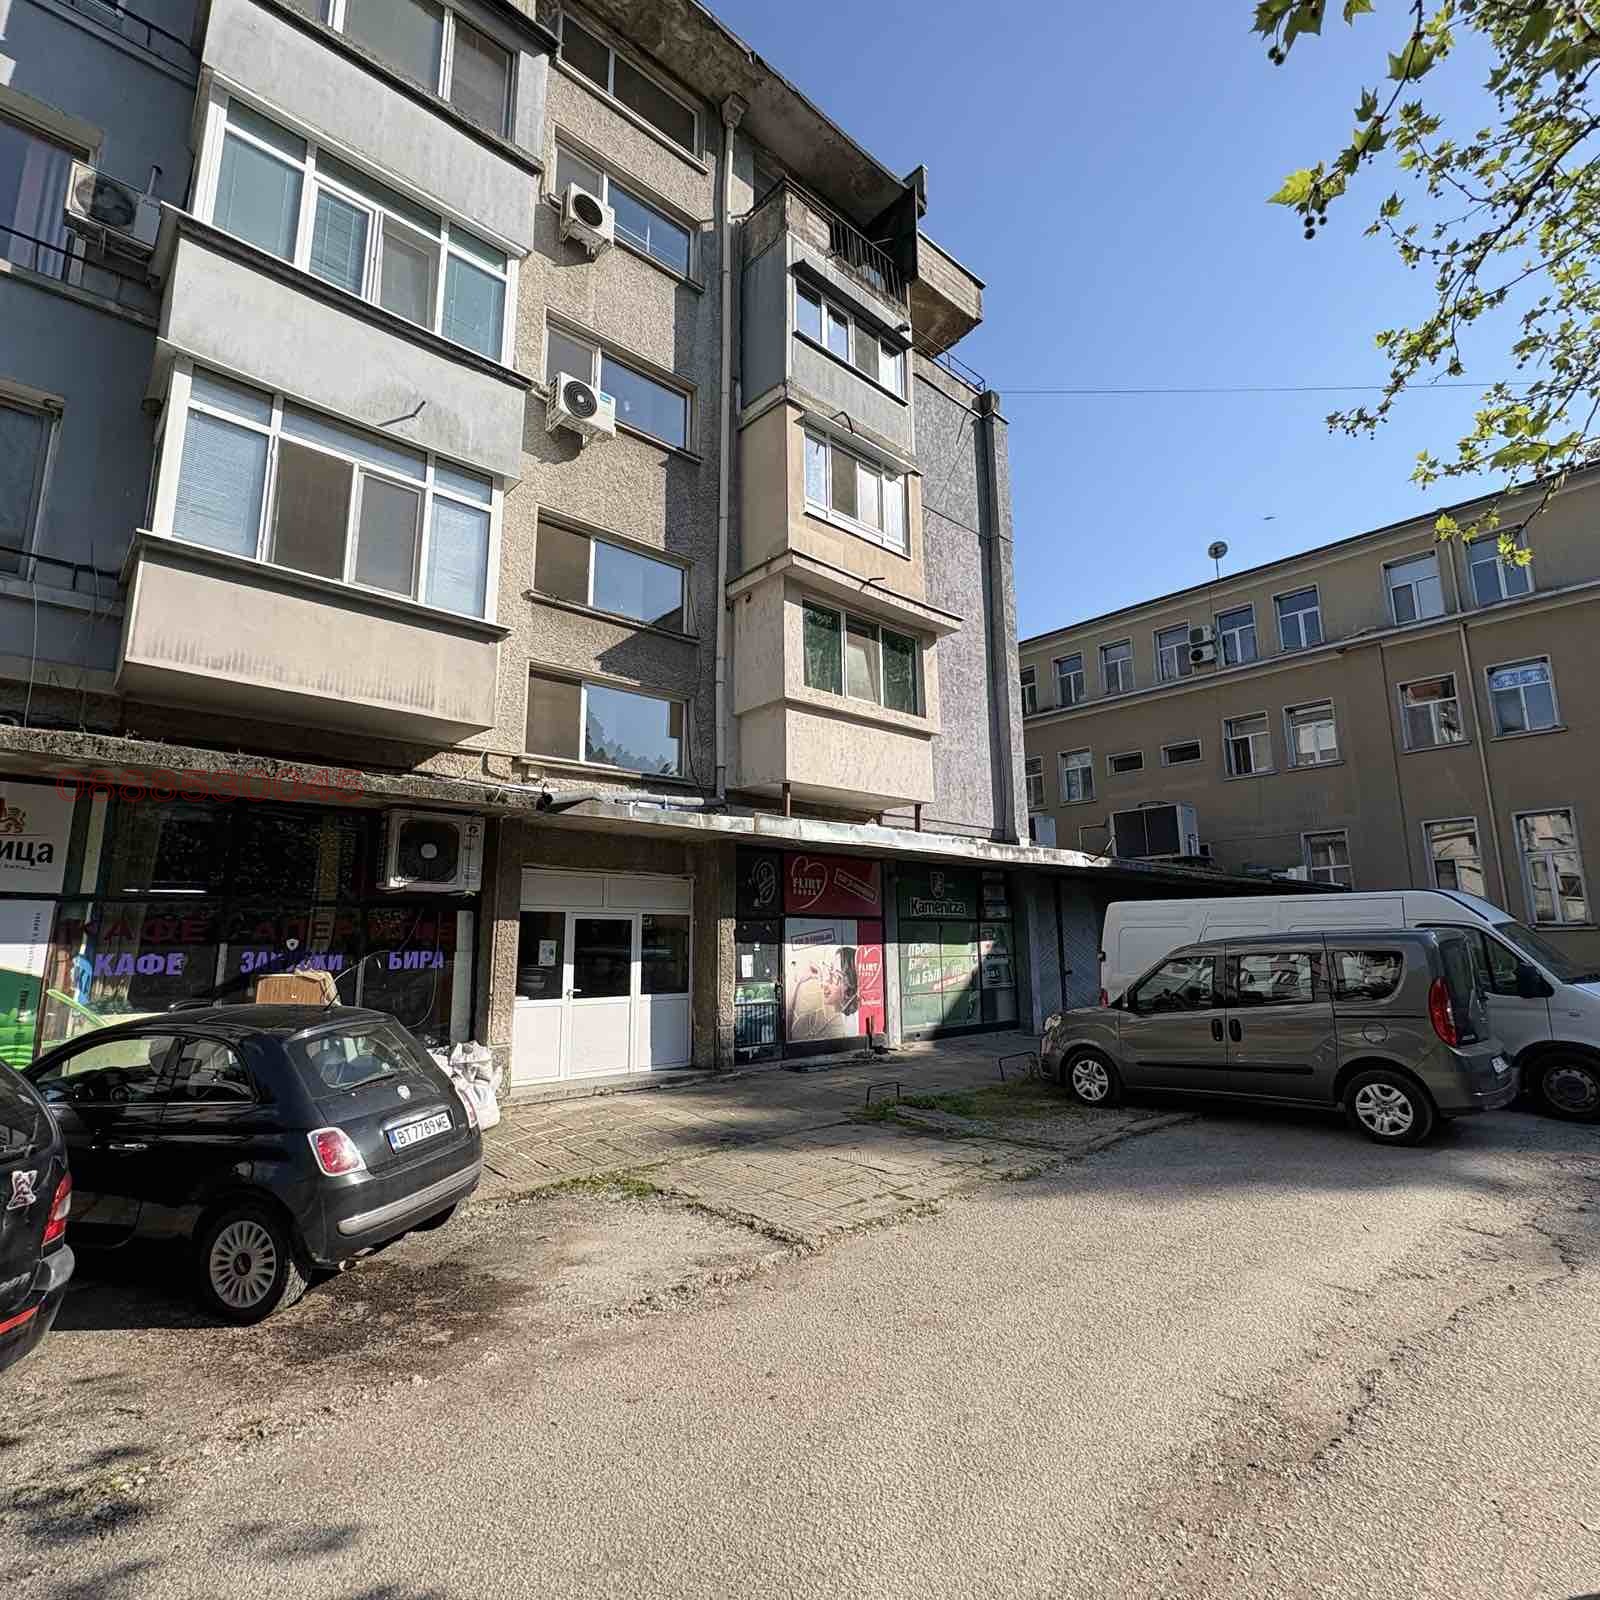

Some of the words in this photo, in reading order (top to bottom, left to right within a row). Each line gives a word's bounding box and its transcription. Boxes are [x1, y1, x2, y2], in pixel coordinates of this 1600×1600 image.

[94, 952, 186, 977] КАФЕ
[240, 951, 344, 973] ЗАКИ
[388, 951, 445, 970] БИРА
